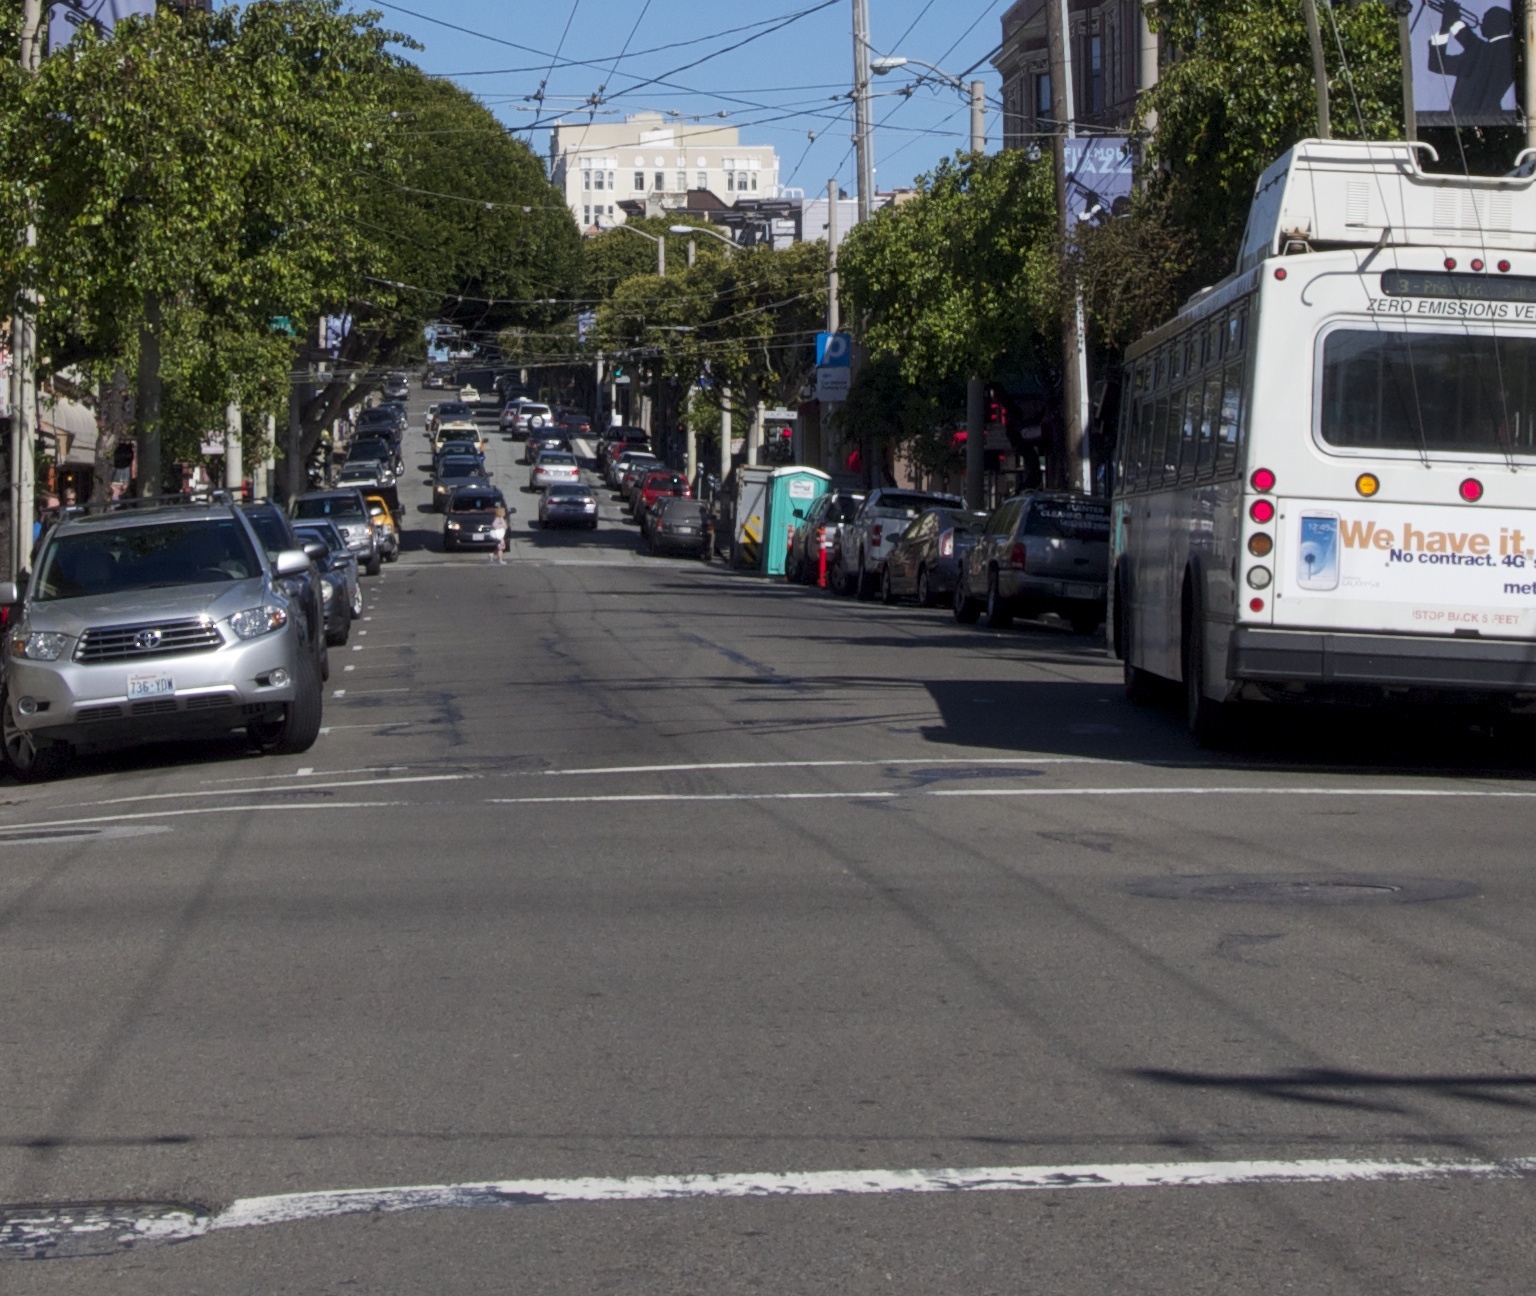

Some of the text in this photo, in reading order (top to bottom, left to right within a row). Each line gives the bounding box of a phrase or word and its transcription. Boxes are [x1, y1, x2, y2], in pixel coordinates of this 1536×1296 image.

[1064, 147, 1133, 161] FILLMOR
[1366, 299, 1412, 313] ZERO
[1417, 300, 1509, 317] EMISSIONS
[823, 336, 847, 364] P
[1340, 520, 1535, 555] We have it.
[1389, 548, 1414, 563] No
[1418, 551, 1497, 567] contract.
[1501, 554, 1525, 568] 4G
[1415, 609, 1445, 621] STOP
